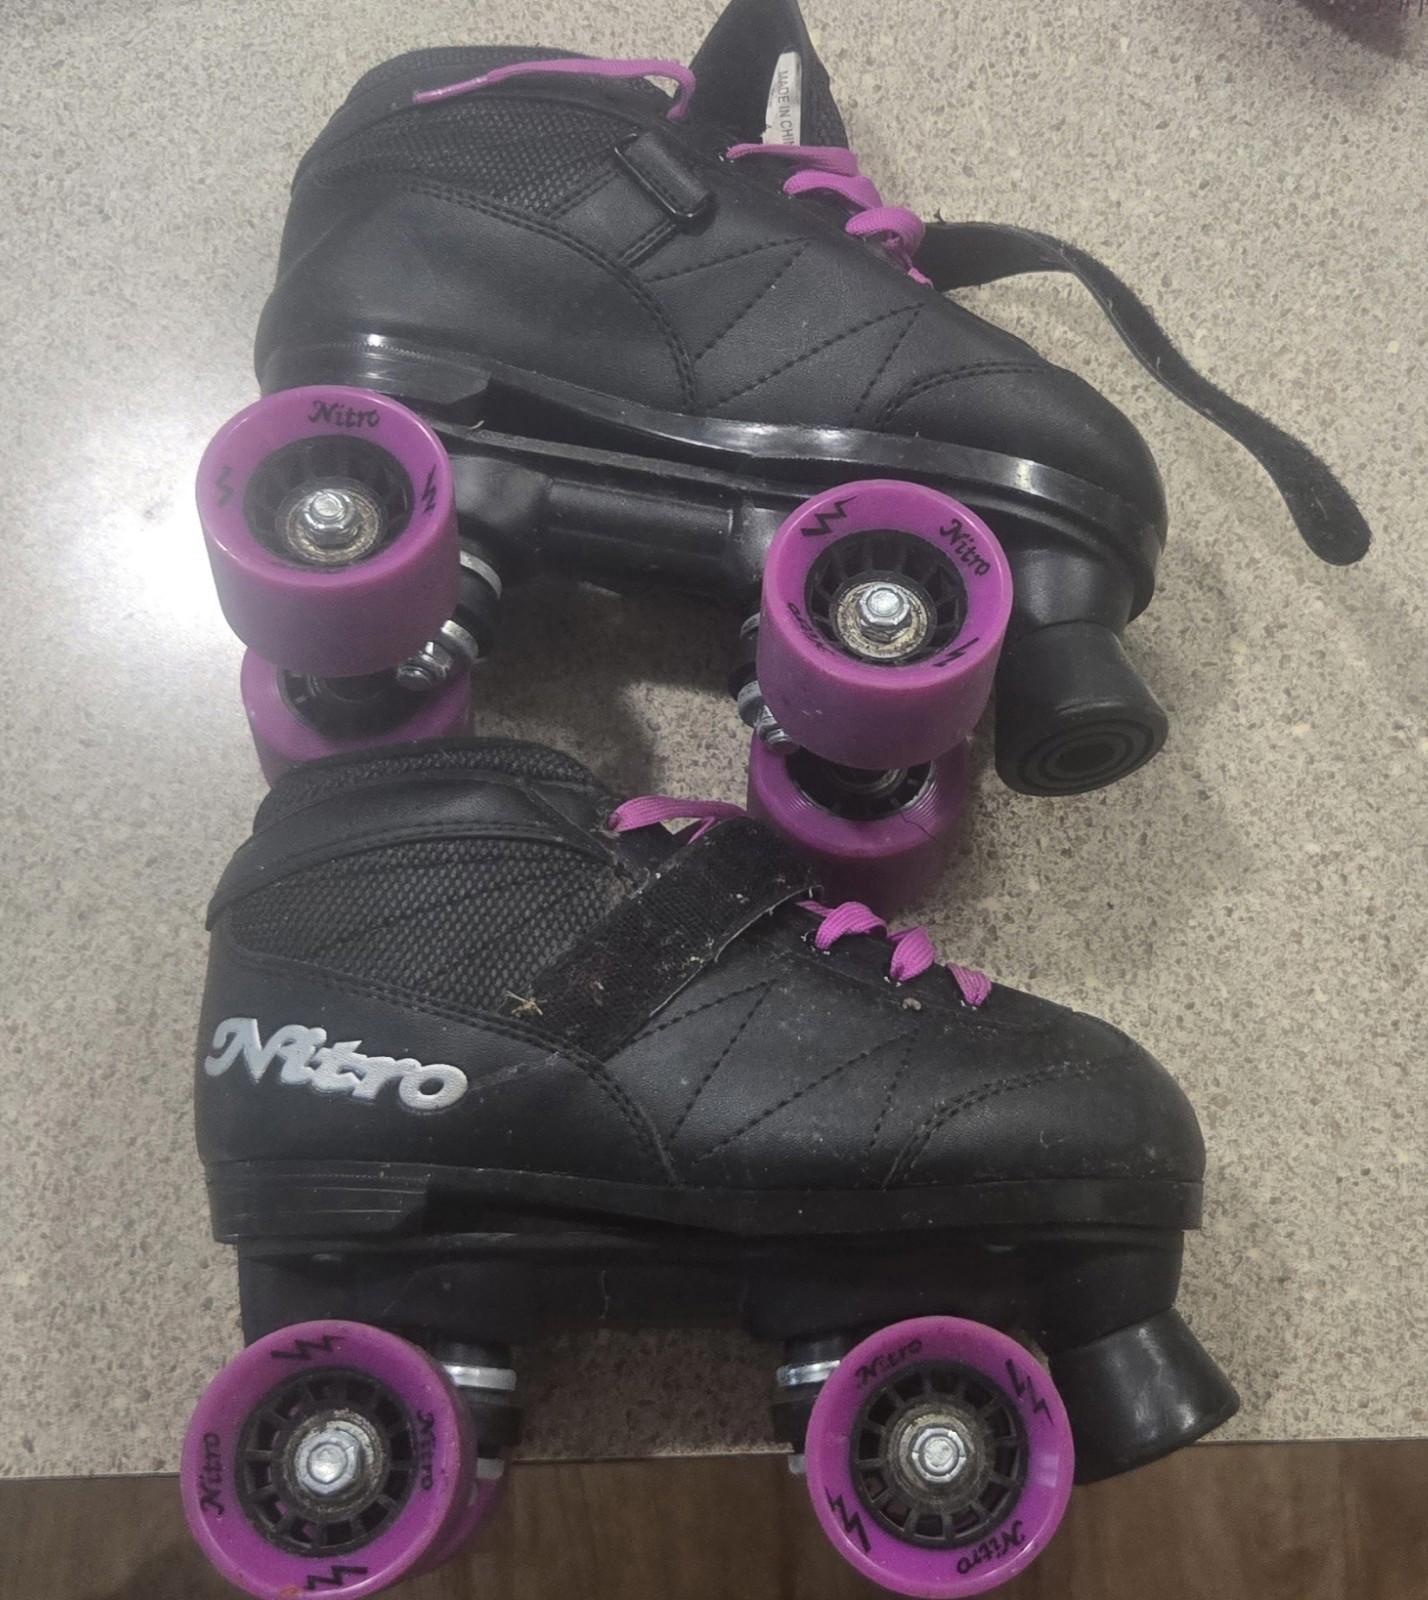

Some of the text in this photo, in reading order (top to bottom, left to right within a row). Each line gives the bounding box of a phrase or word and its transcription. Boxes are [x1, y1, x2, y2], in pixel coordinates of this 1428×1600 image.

[777, 70, 790, 104] MADE
[778, 105, 791, 118] IN
[307, 400, 380, 428] Nitro
[939, 518, 991, 577] Nitro
[204, 1016, 469, 1110] Nitro
[855, 1339, 923, 1389] Nitro
[199, 1432, 225, 1516] Nitro
[417, 1409, 436, 1491] Nitro
[955, 1519, 1026, 1575] Nitro
